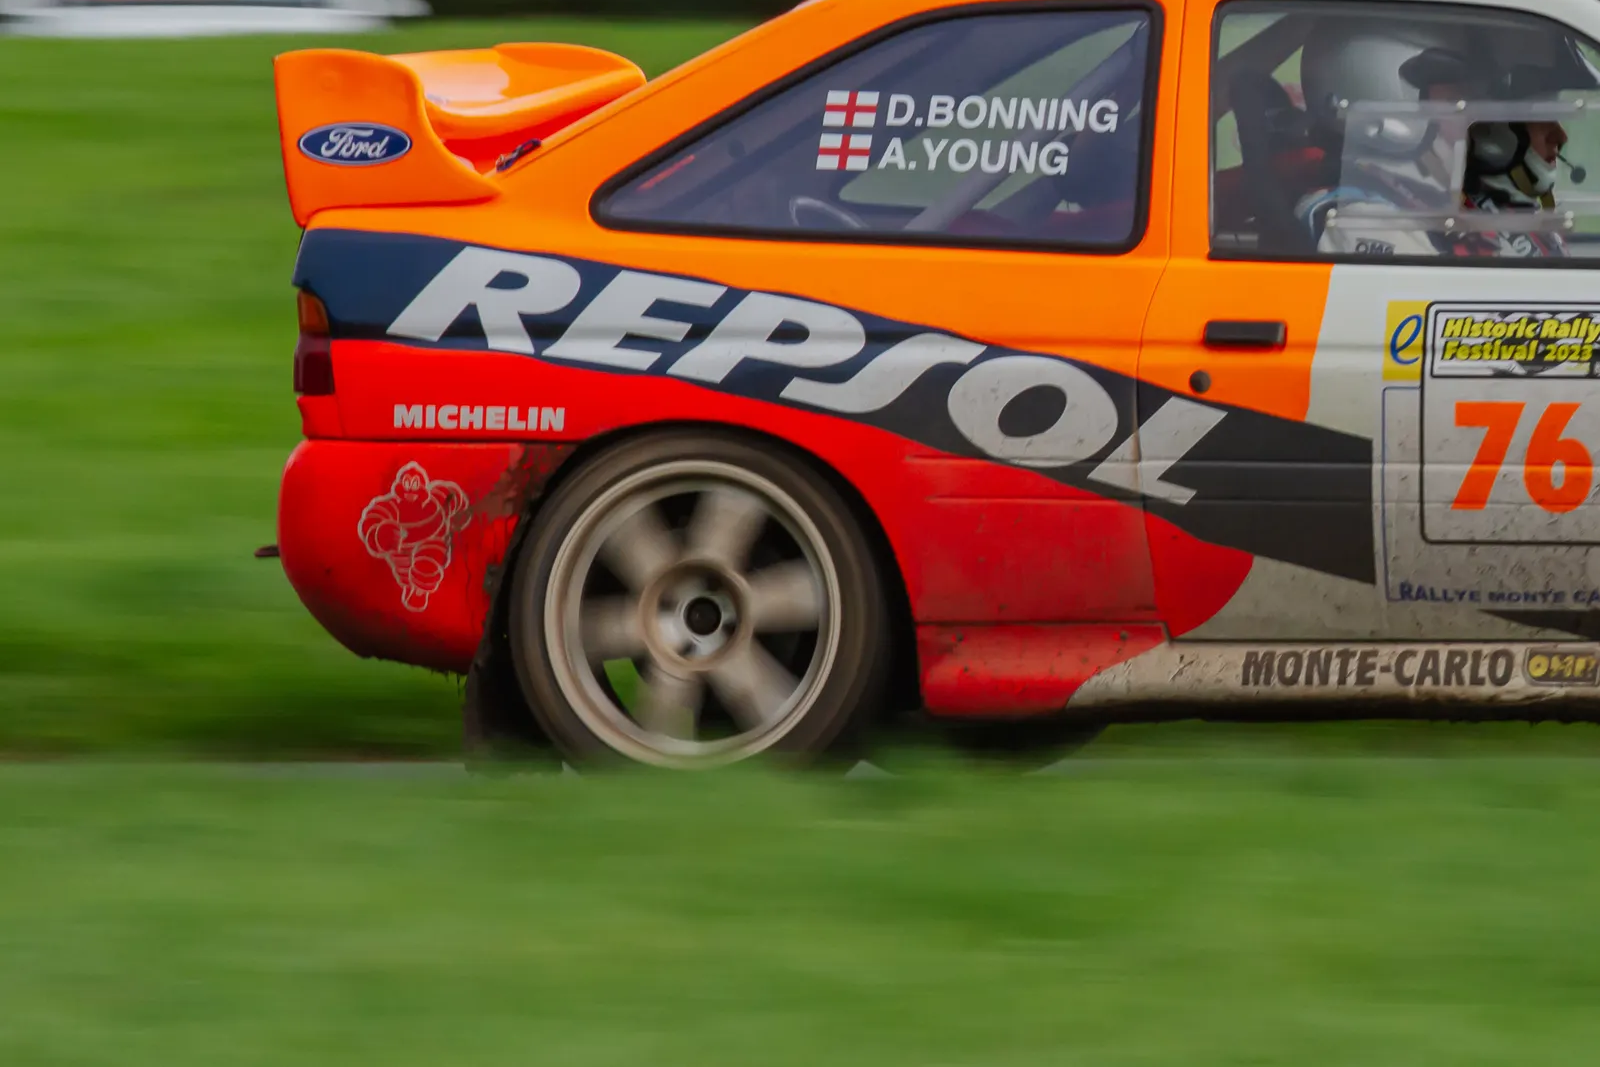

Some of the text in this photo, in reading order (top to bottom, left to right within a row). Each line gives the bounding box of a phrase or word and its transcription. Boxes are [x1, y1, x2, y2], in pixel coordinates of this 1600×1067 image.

[885, 94, 1119, 134] D.BONNING
[321, 127, 390, 158] Ford
[877, 137, 1070, 176] A.YOUNG
[1441, 316, 1538, 339] Historic
[1441, 338, 1539, 362] Festival
[1543, 342, 1594, 362] 2023
[386, 246, 1229, 505] REPSOL
[393, 403, 567, 432] MICHELIN
[1451, 401, 1593, 514] 76
[1400, 582, 1481, 603] RALLYE
[1239, 647, 1516, 687] MONTE-CARLO
